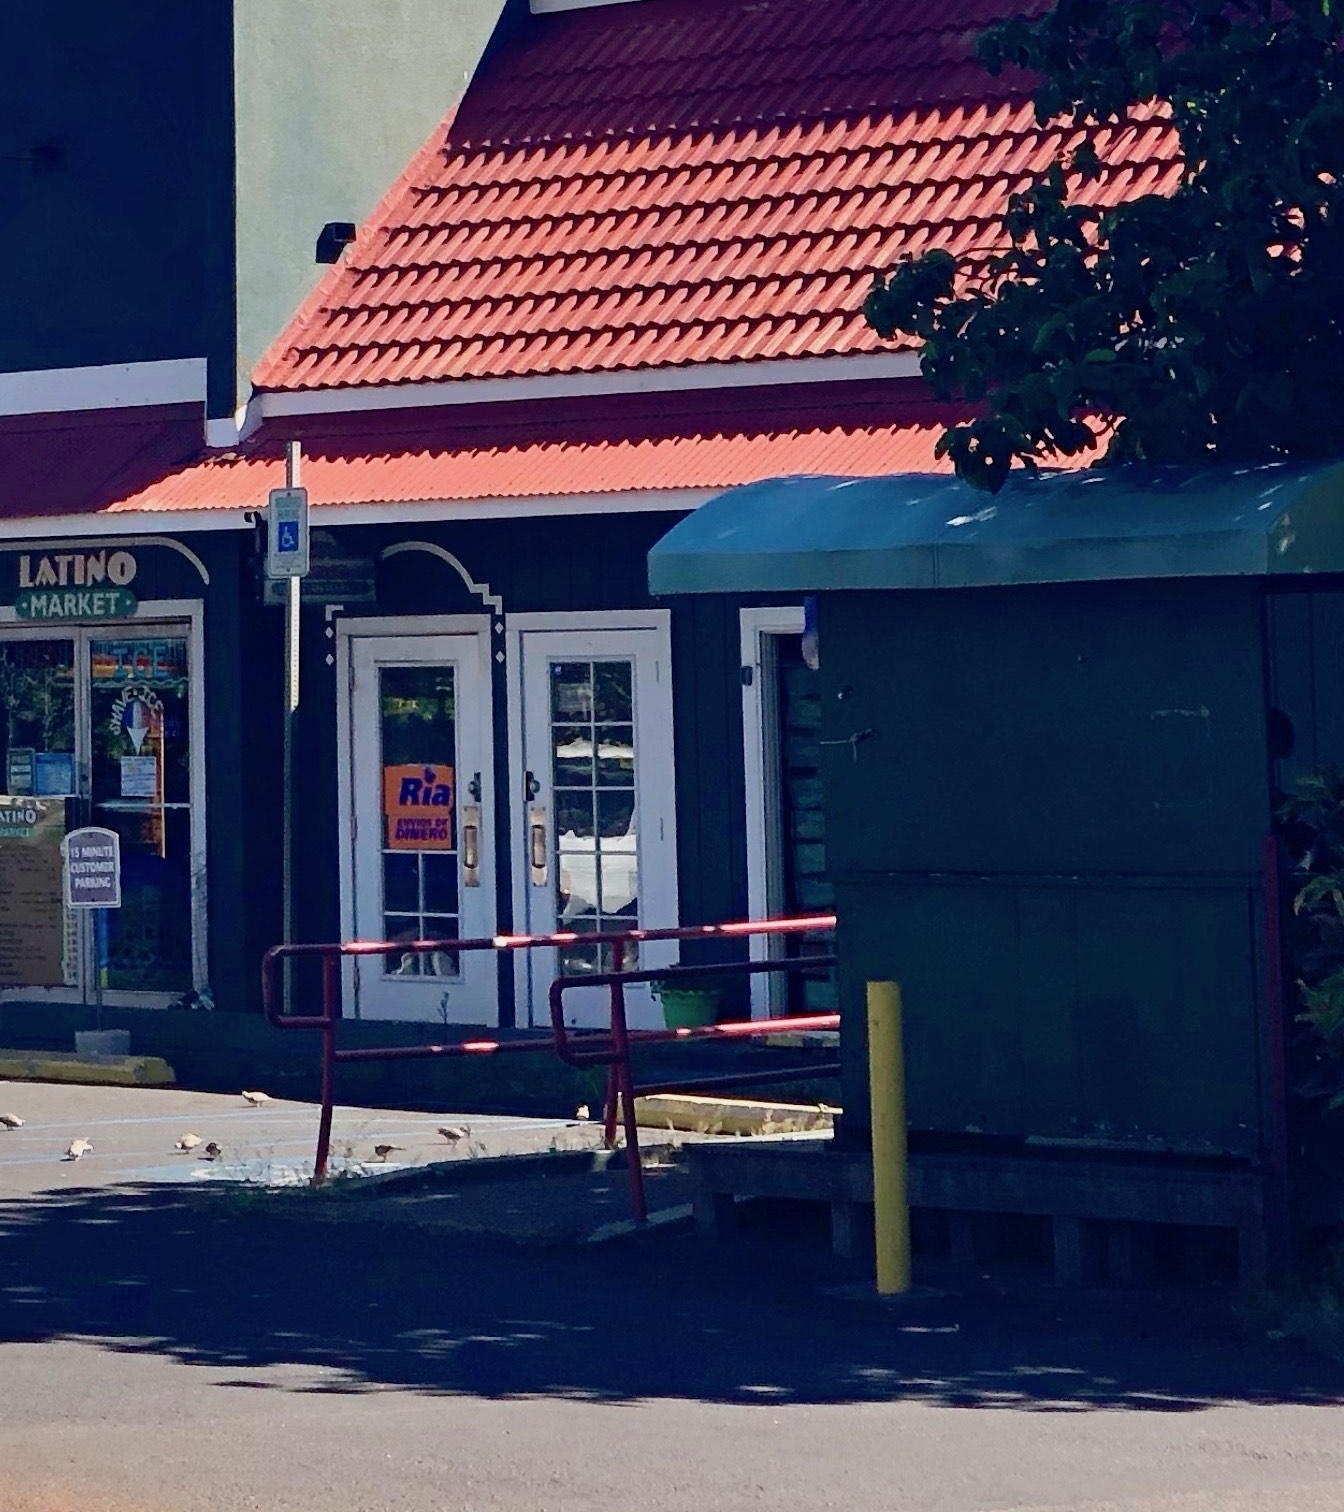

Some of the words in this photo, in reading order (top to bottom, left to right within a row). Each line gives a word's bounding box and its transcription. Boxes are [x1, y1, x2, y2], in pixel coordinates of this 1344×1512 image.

[19, 549, 137, 588] LATINO
[30, 592, 120, 618] MARKET
[112, 646, 170, 680] ICE
[399, 770, 451, 807] Ria
[395, 828, 449, 840] DINERO
[71, 846, 80, 858] 15
[81, 845, 113, 857] MINUTE
[70, 861, 114, 874] CUSTOMER
[74, 876, 111, 888] PARKING
